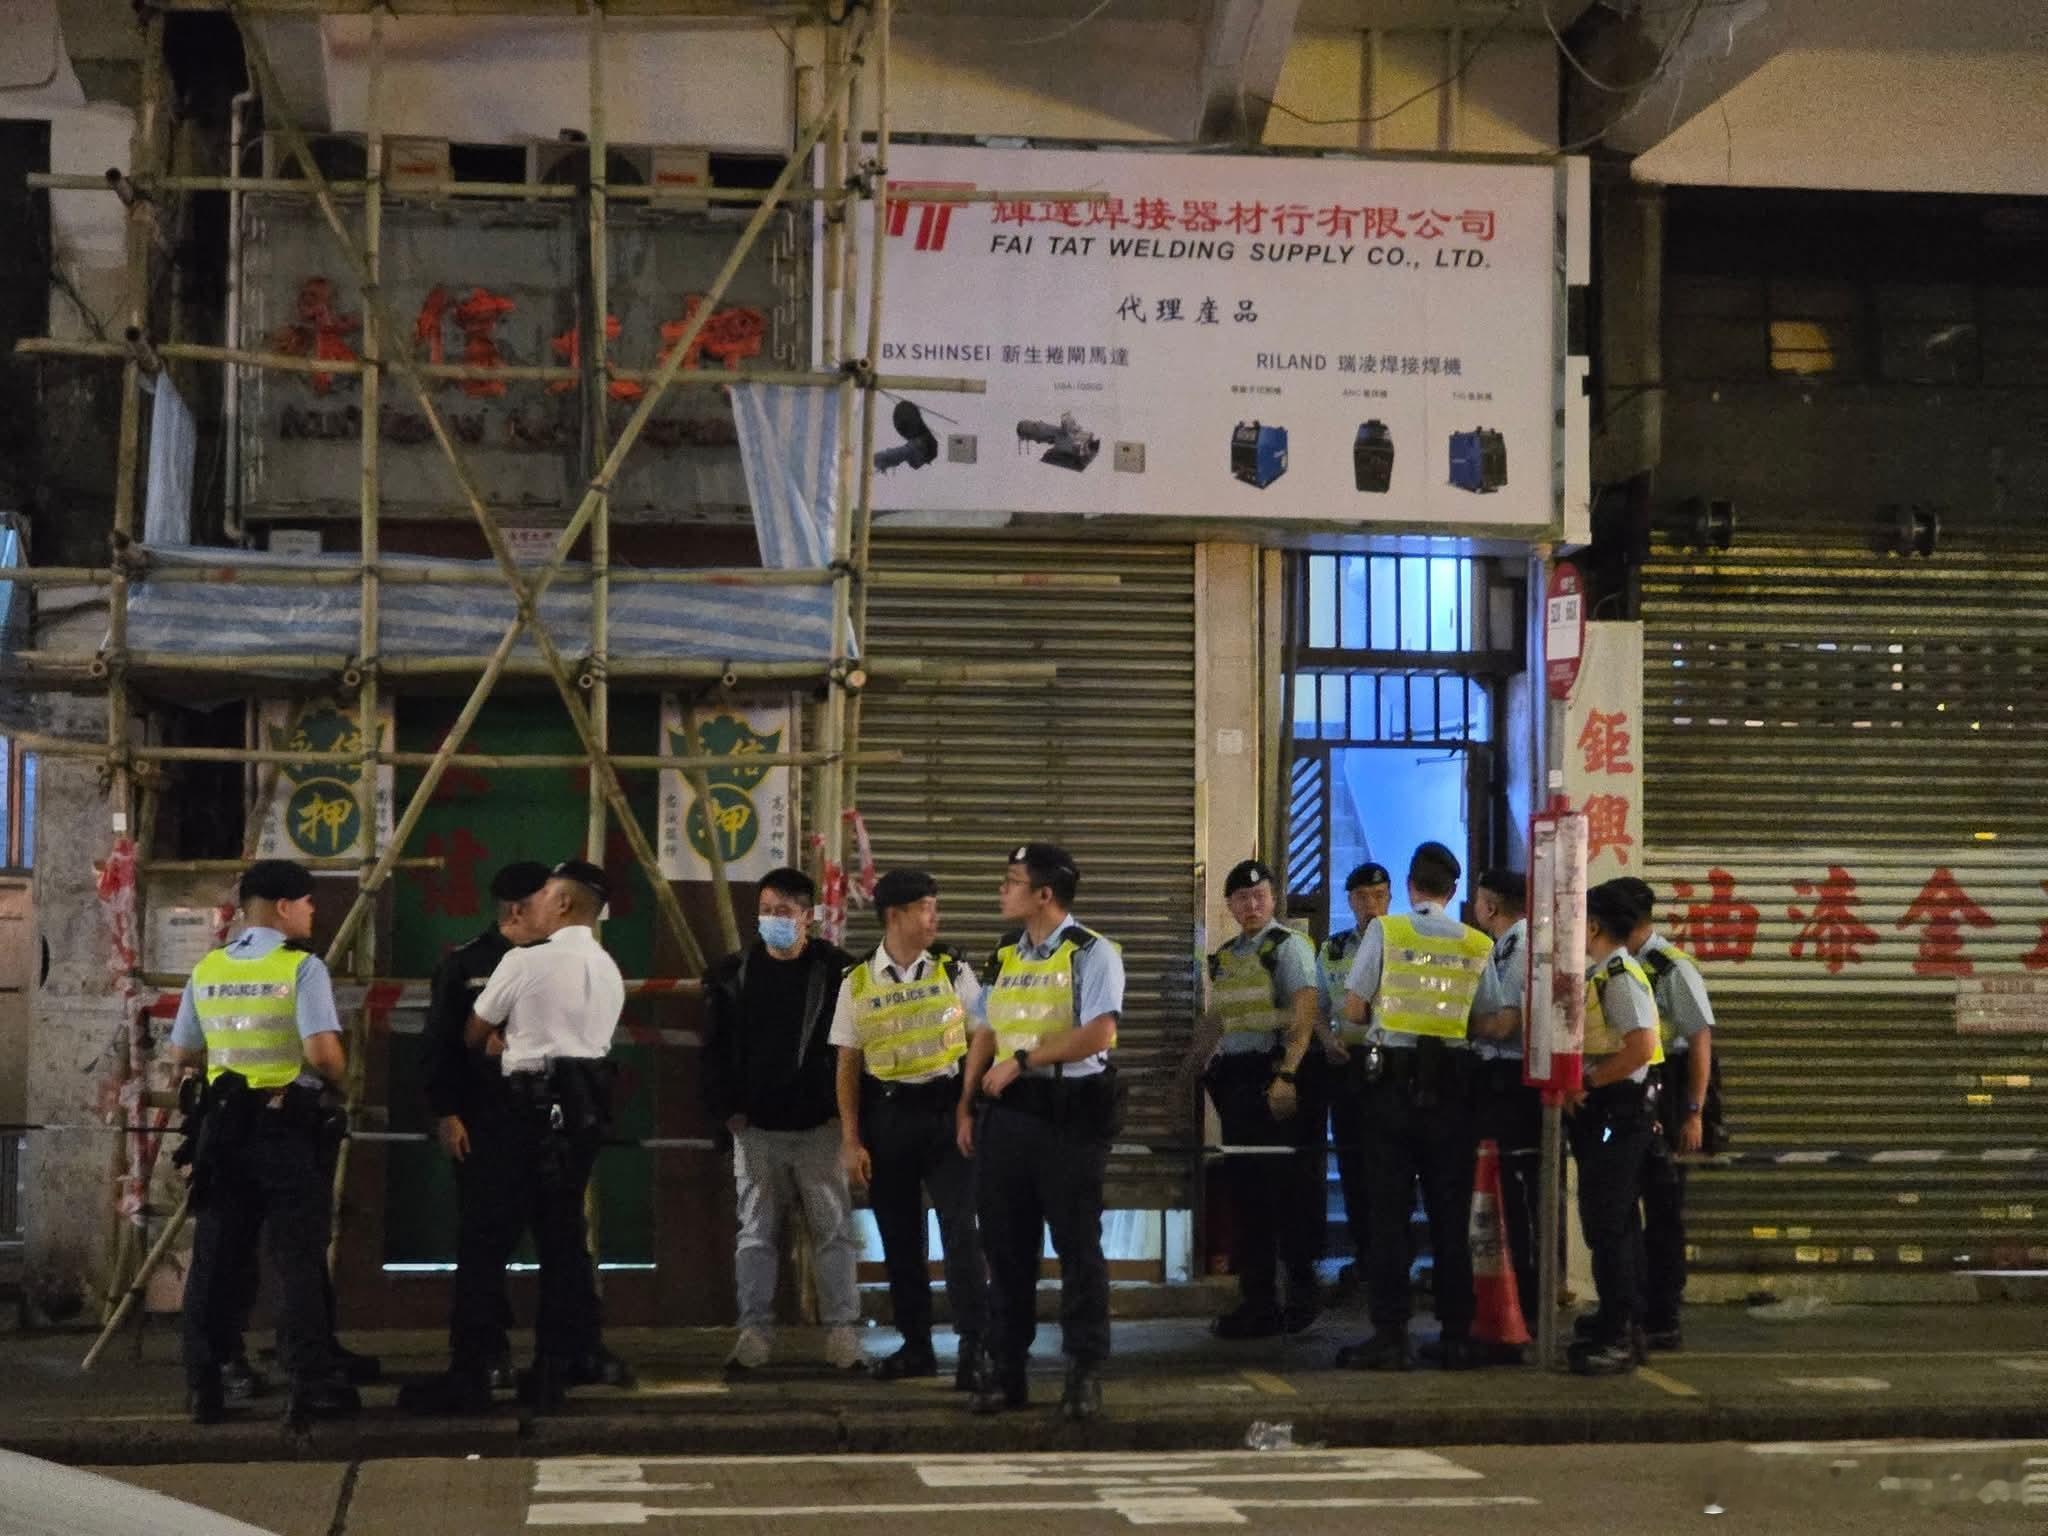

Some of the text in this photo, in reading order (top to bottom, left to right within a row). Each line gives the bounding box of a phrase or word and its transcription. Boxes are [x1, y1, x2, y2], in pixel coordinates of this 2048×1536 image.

[990, 235, 1492, 270] FAI TAT WELDING SUPPLY CO., LTD.
[882, 343, 907, 360] BX
[911, 343, 991, 362] SHINSEI
[1256, 352, 1327, 371] RILAND
[297, 793, 353, 851] 押
[1668, 864, 2048, 976] 油漆金
[219, 984, 258, 996] POLICE
[886, 988, 926, 1004] POLICE
